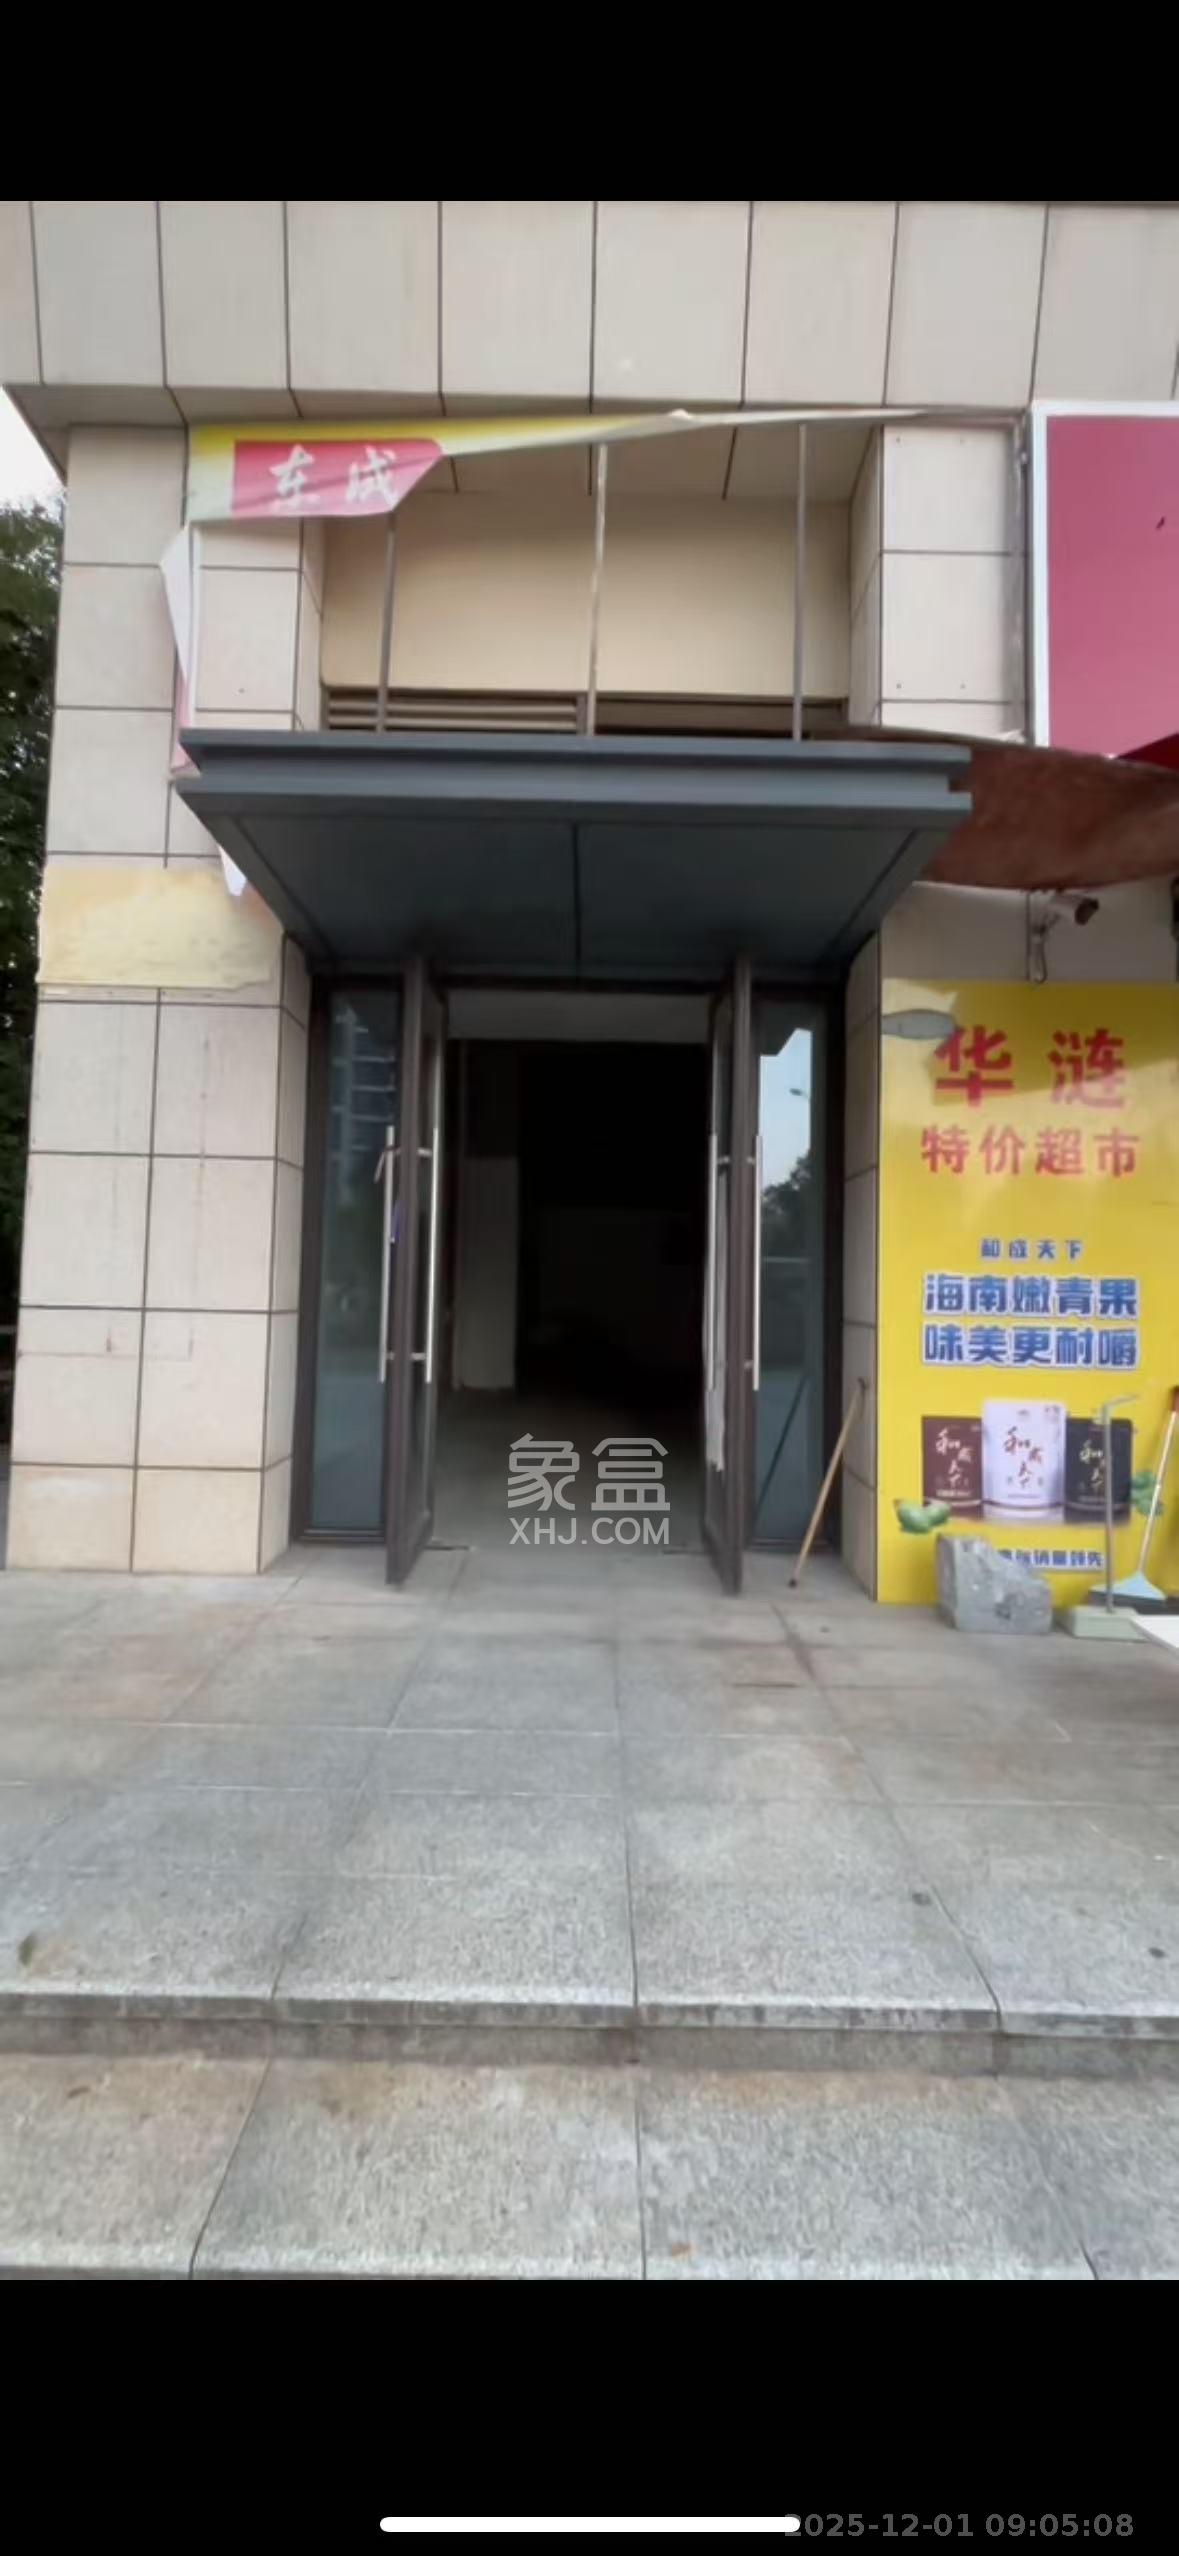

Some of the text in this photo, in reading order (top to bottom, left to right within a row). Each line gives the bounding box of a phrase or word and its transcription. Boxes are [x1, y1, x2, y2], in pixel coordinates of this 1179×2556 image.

[921, 1124, 1140, 1178] 特价超市
[980, 1238, 1083, 1260] 和成天下
[924, 1272, 1138, 1317] 海南嫩青果
[924, 1323, 1138, 1367] 味美更耐嚼
